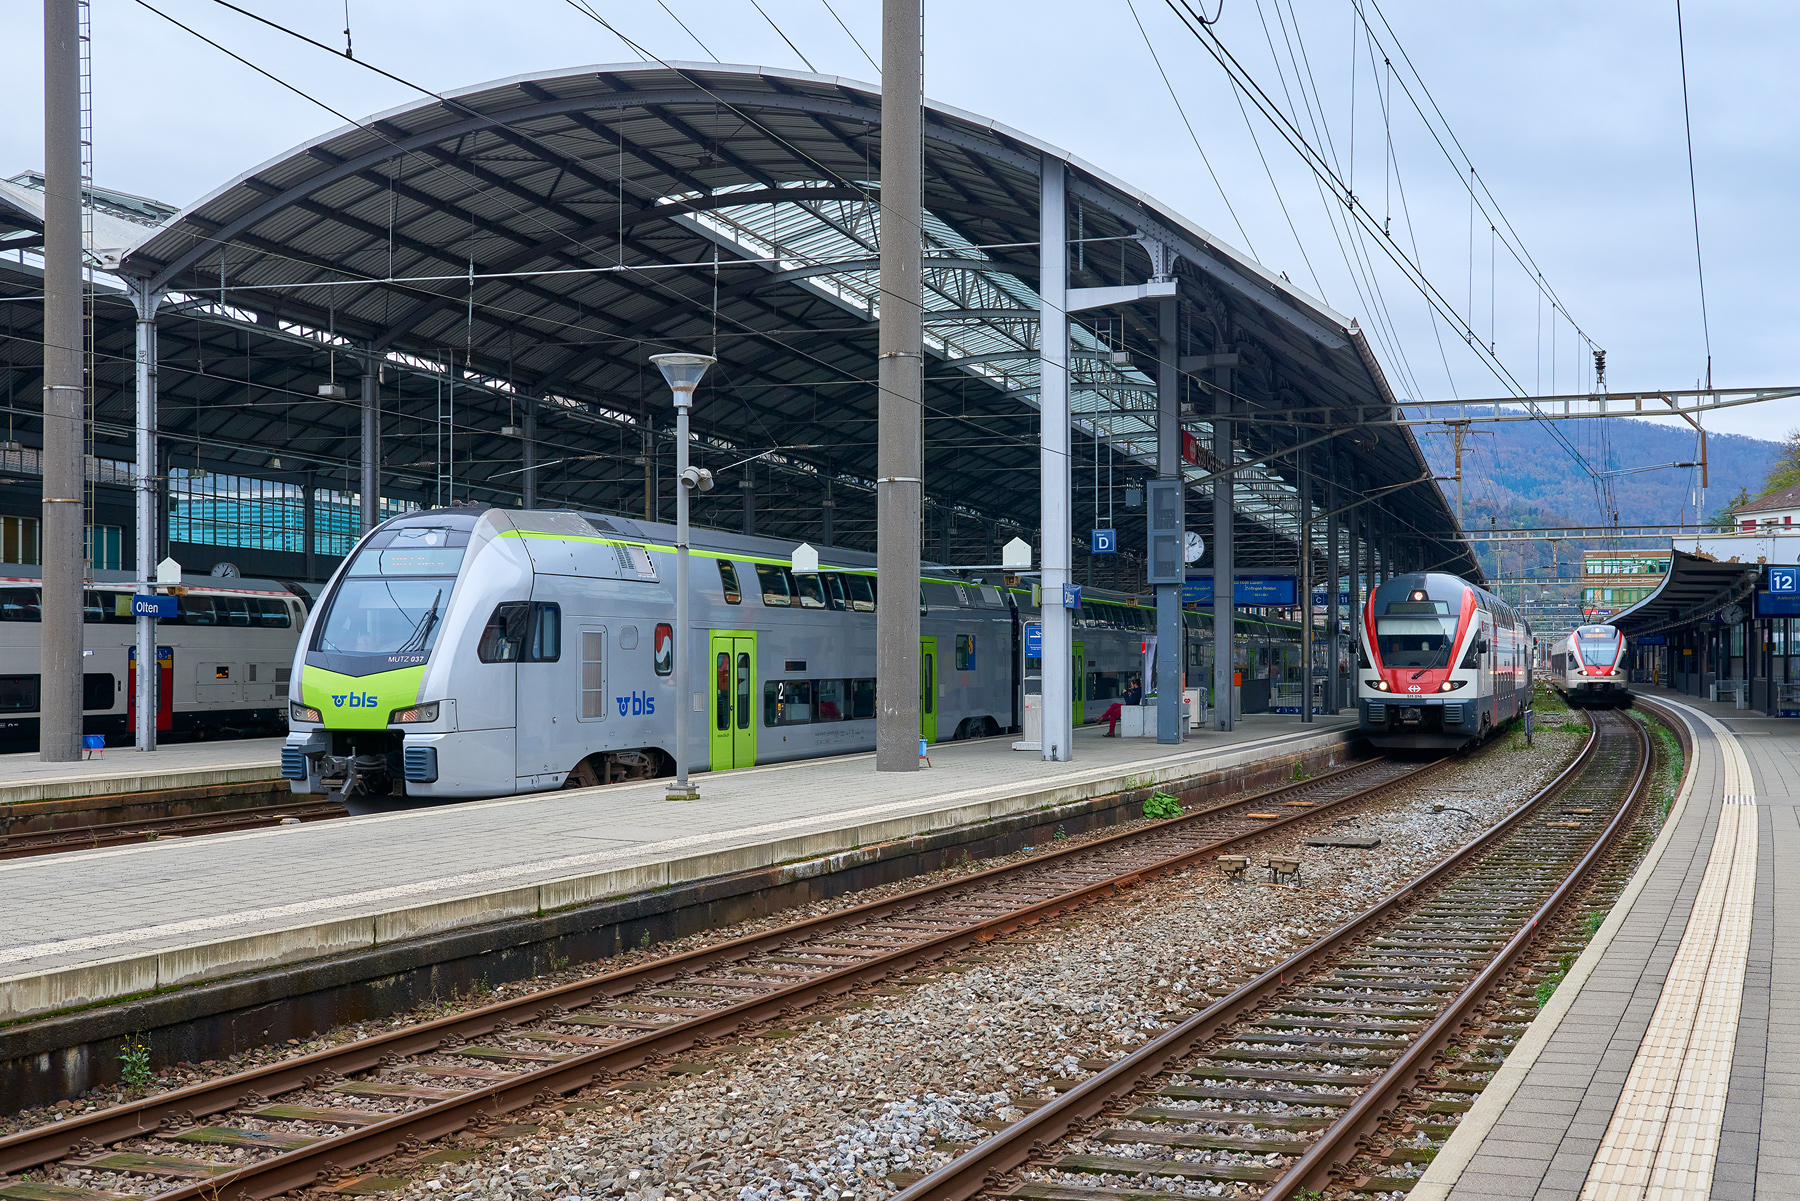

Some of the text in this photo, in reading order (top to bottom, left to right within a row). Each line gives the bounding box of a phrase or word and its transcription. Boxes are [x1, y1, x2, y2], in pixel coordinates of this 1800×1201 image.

[1099, 537, 1109, 549] D
[1773, 576, 1793, 590] 12
[136, 601, 159, 614] Olten
[778, 682, 784, 700] 2
[349, 691, 378, 708] bls
[633, 690, 655, 716] bls
